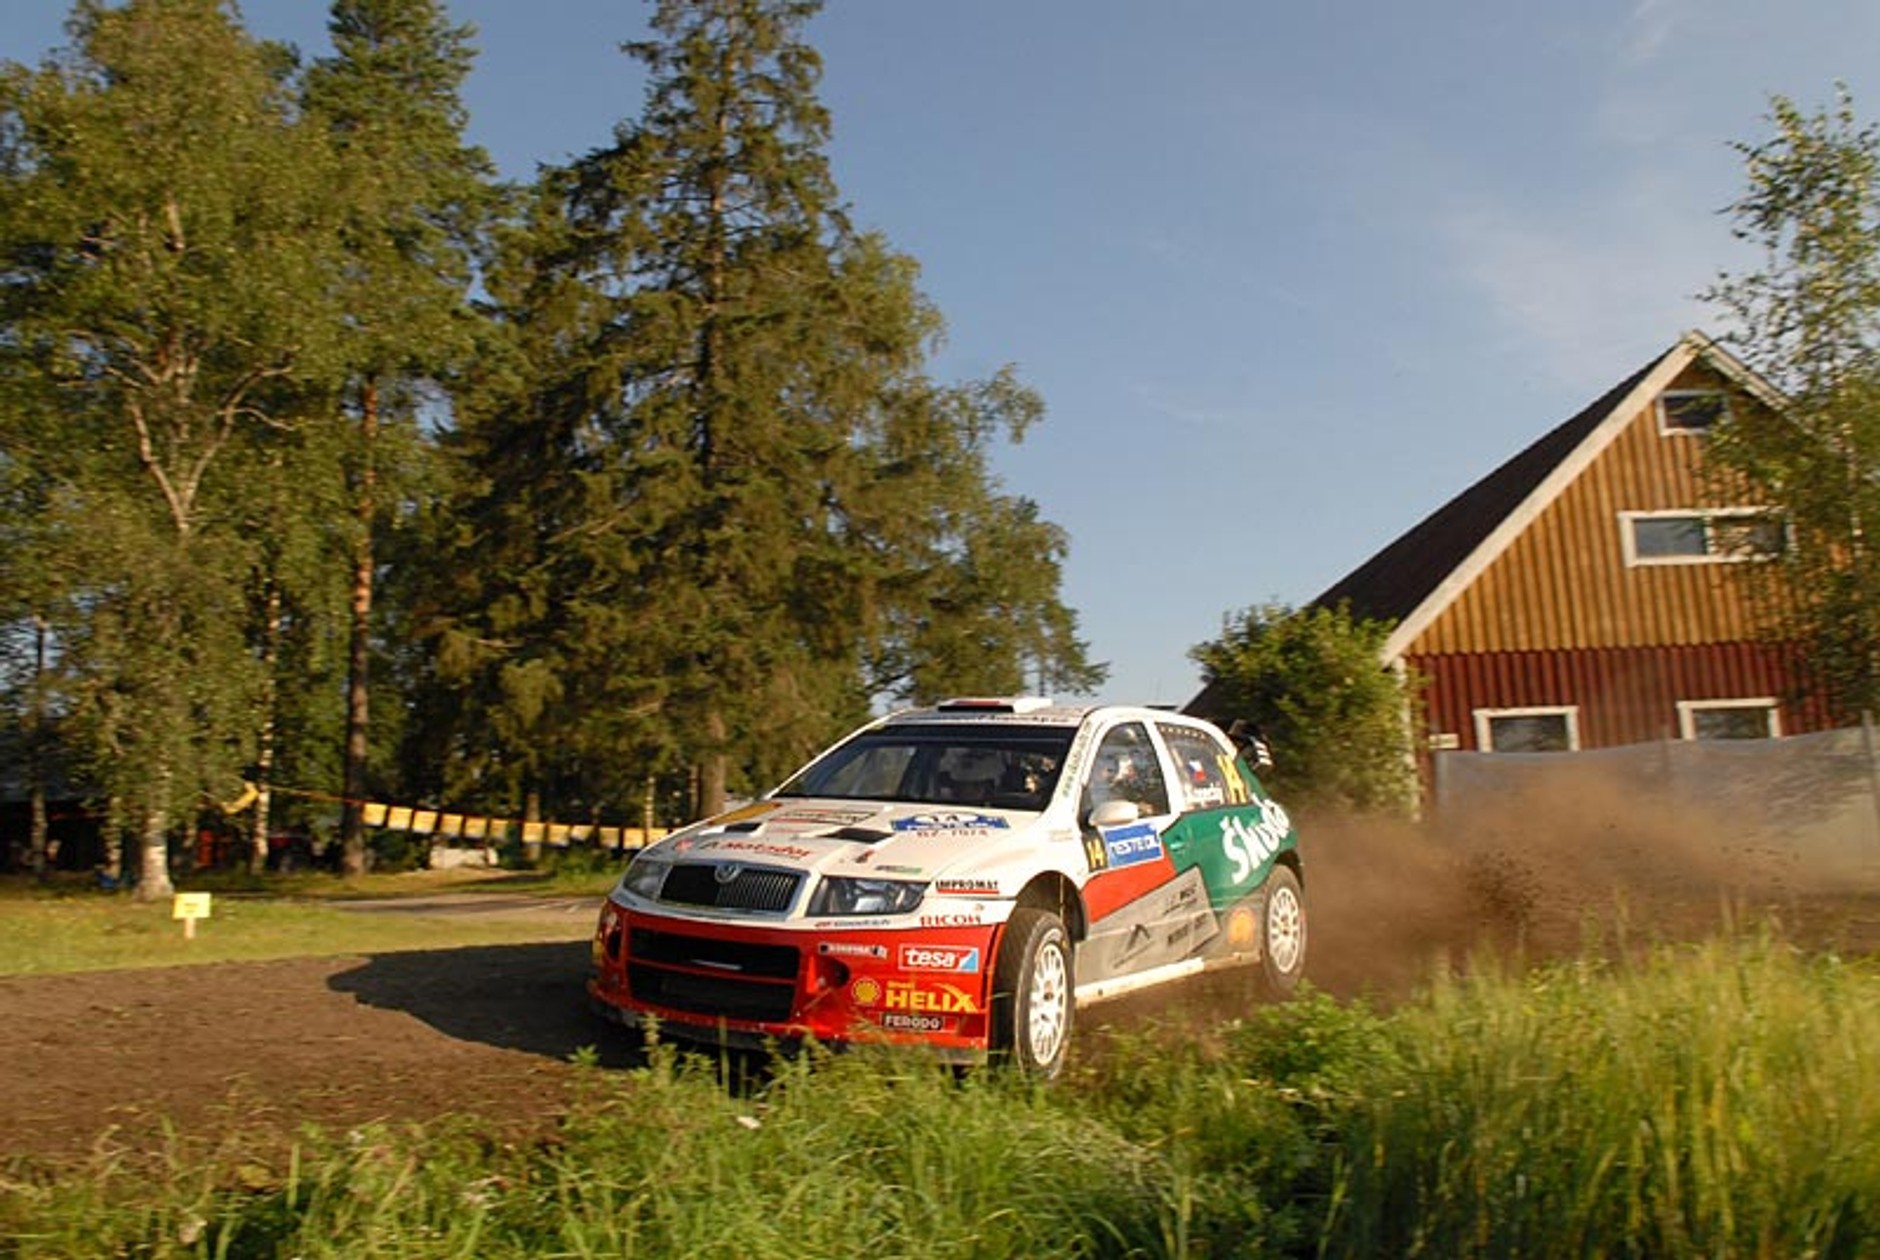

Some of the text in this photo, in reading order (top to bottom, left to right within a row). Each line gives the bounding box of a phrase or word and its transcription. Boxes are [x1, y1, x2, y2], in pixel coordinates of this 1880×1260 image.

[1087, 838, 1105, 869] 14
[920, 914, 982, 927] RICOH
[904, 949, 957, 968] tesa
[885, 982, 978, 1013] HELIX
[884, 1015, 941, 1029] FERODO
